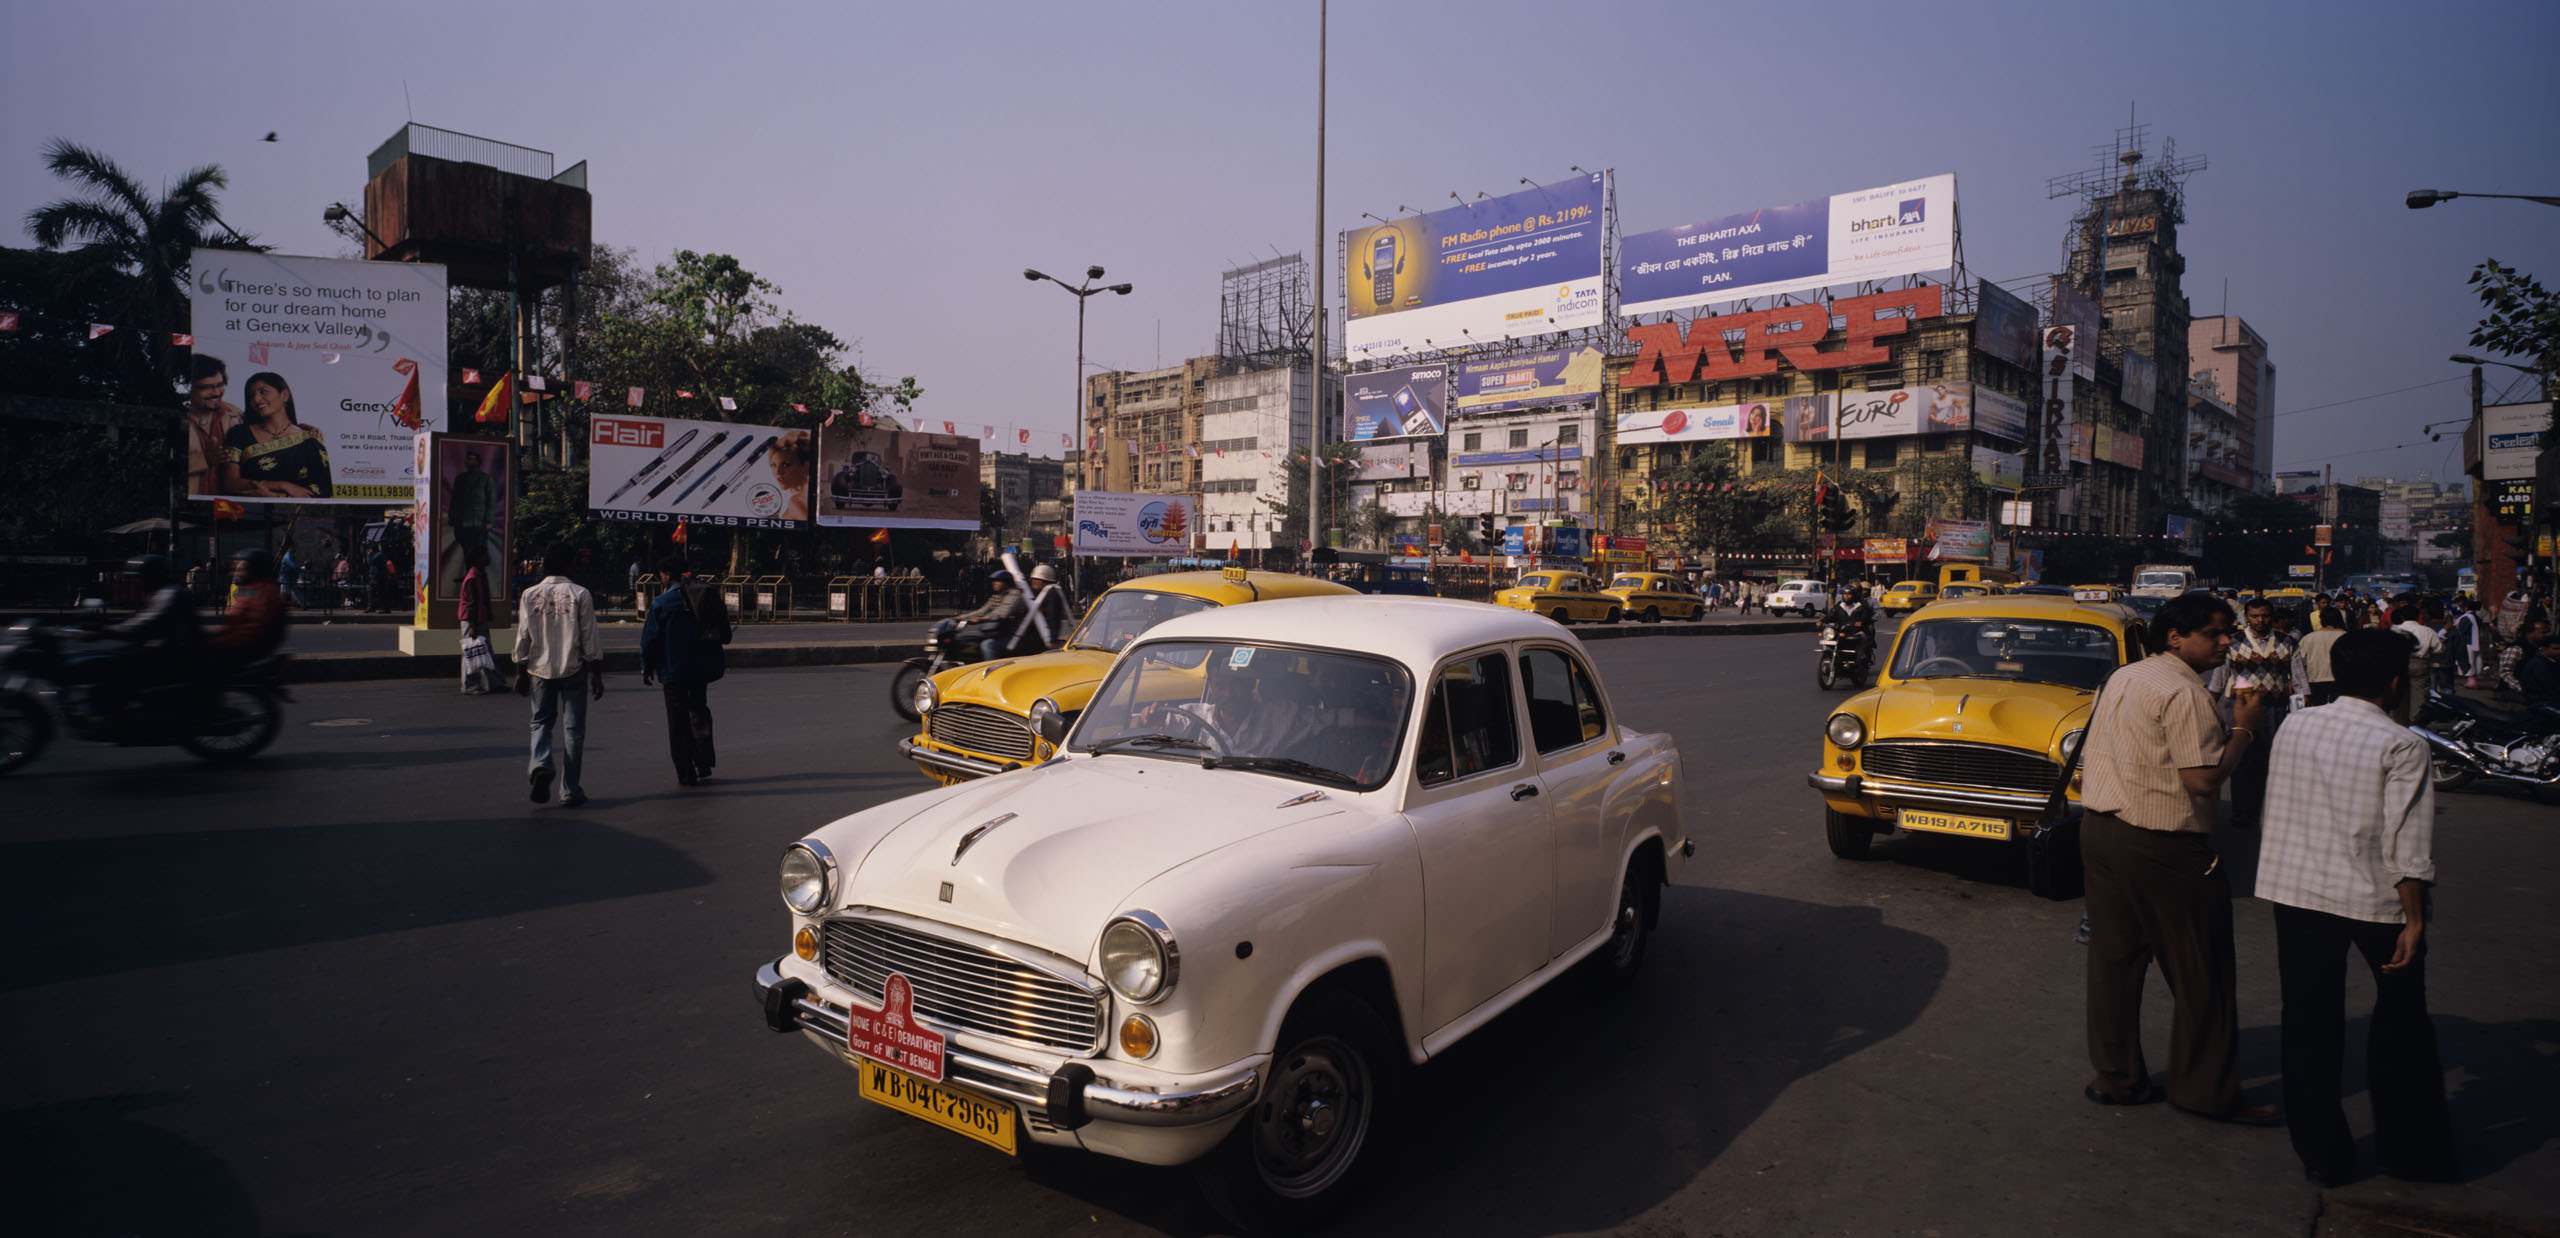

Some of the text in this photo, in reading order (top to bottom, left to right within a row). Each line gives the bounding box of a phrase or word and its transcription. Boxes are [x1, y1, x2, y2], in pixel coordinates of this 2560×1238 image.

[1442, 235, 1458, 248] FM
[1459, 230, 1488, 244] Radio
[1490, 222, 1521, 240] phone
[1523, 216, 1536, 232] @
[1538, 214, 1555, 228] Rs.
[1851, 215, 1896, 232] bharti
[1676, 224, 1761, 247] THE BHARTI AXA
[1446, 252, 1468, 264] FREE
[1500, 244, 1515, 254] calls
[1534, 236, 1552, 247] 2000
[1464, 262, 1487, 274] FREE
[1487, 257, 1518, 270] incoming
[1518, 254, 1529, 264] for
[1702, 272, 1732, 285] PLAN.
[225, 280, 421, 304] There's so much to plan
[1576, 288, 1597, 298] TATA
[225, 299, 386, 319] for our dream home
[1557, 298, 1598, 312] indicom
[225, 318, 240, 331] at
[246, 318, 310, 334] Genexx
[1618, 284, 1942, 388] MRF
[1482, 374, 1504, 387] SUPER
[1838, 400, 1900, 428] EURO
[594, 421, 662, 447] Flair
[336, 486, 359, 497] 2438
[600, 510, 796, 529] WORLD CLASS PENS
[2500, 505, 2516, 514] at
[852, 1015, 870, 1032] HOME
[882, 1024, 887, 1037] &
[898, 1030, 942, 1056] DEPARTMENT
[909, 1052, 936, 1073] BENGAL
